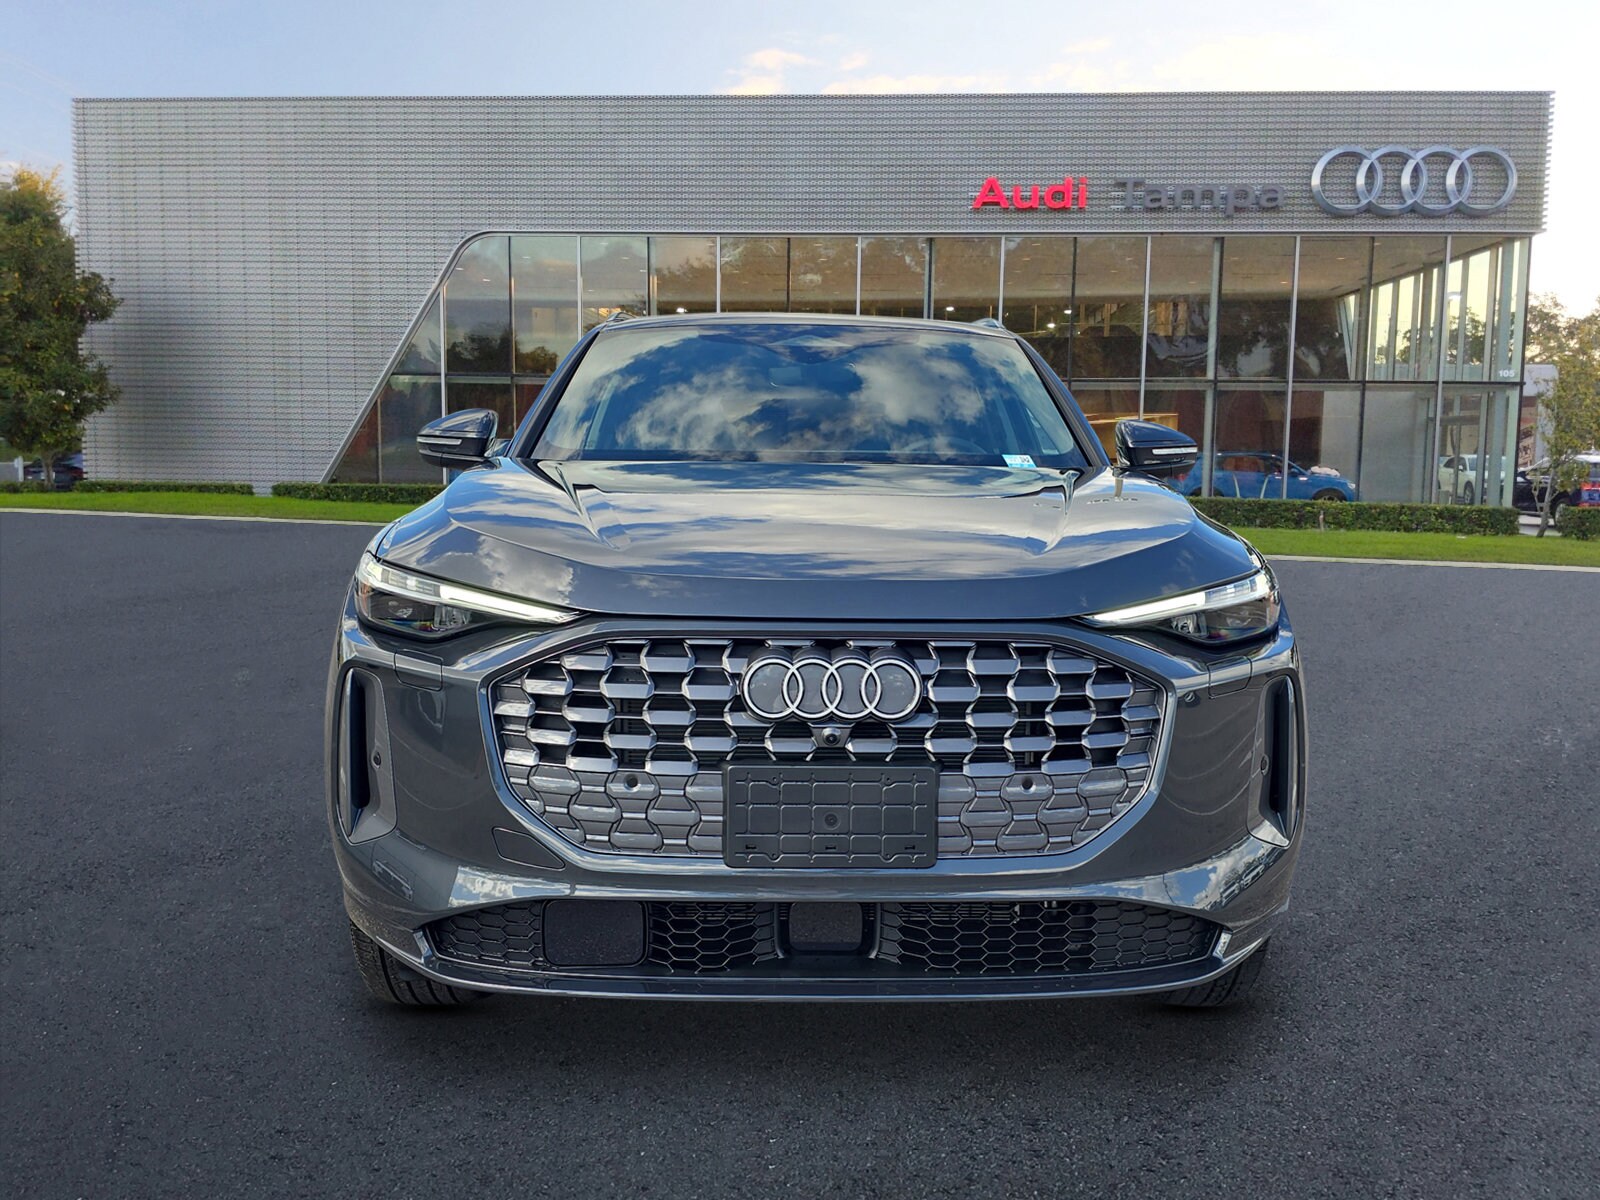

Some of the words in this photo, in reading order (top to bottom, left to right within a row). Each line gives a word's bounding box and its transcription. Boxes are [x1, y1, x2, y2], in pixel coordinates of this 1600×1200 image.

[972, 176, 1088, 210] Audi
[1114, 177, 1286, 218] Tampa
[1499, 369, 1515, 378] 105
